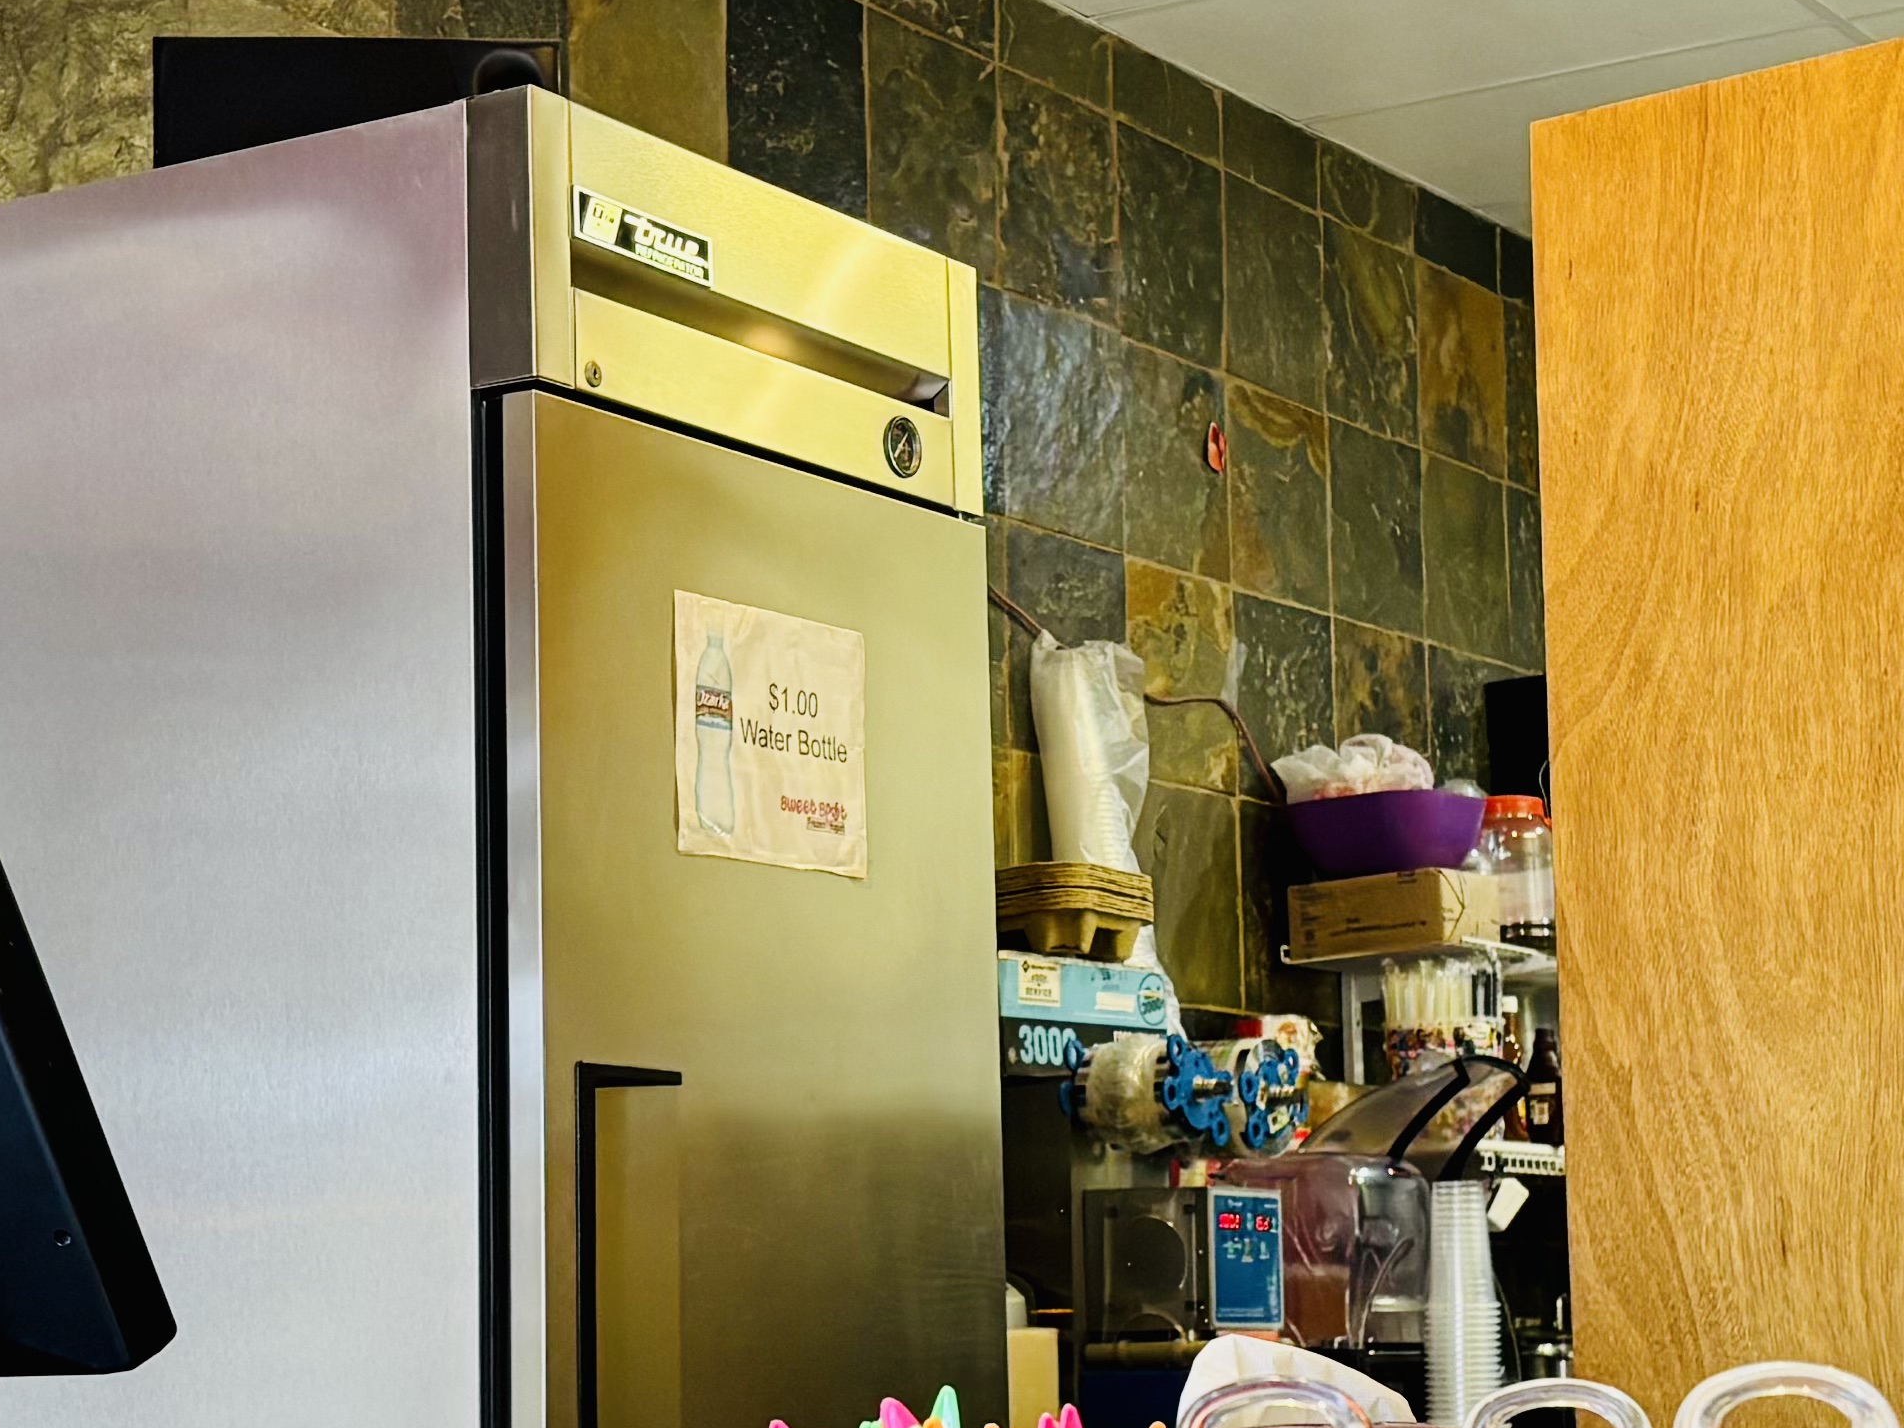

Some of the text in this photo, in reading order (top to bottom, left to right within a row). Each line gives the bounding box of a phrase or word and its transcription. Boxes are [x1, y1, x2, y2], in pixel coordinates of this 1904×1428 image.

[769, 683, 818, 718] $1.00
[740, 717, 847, 763] Water Bottle
